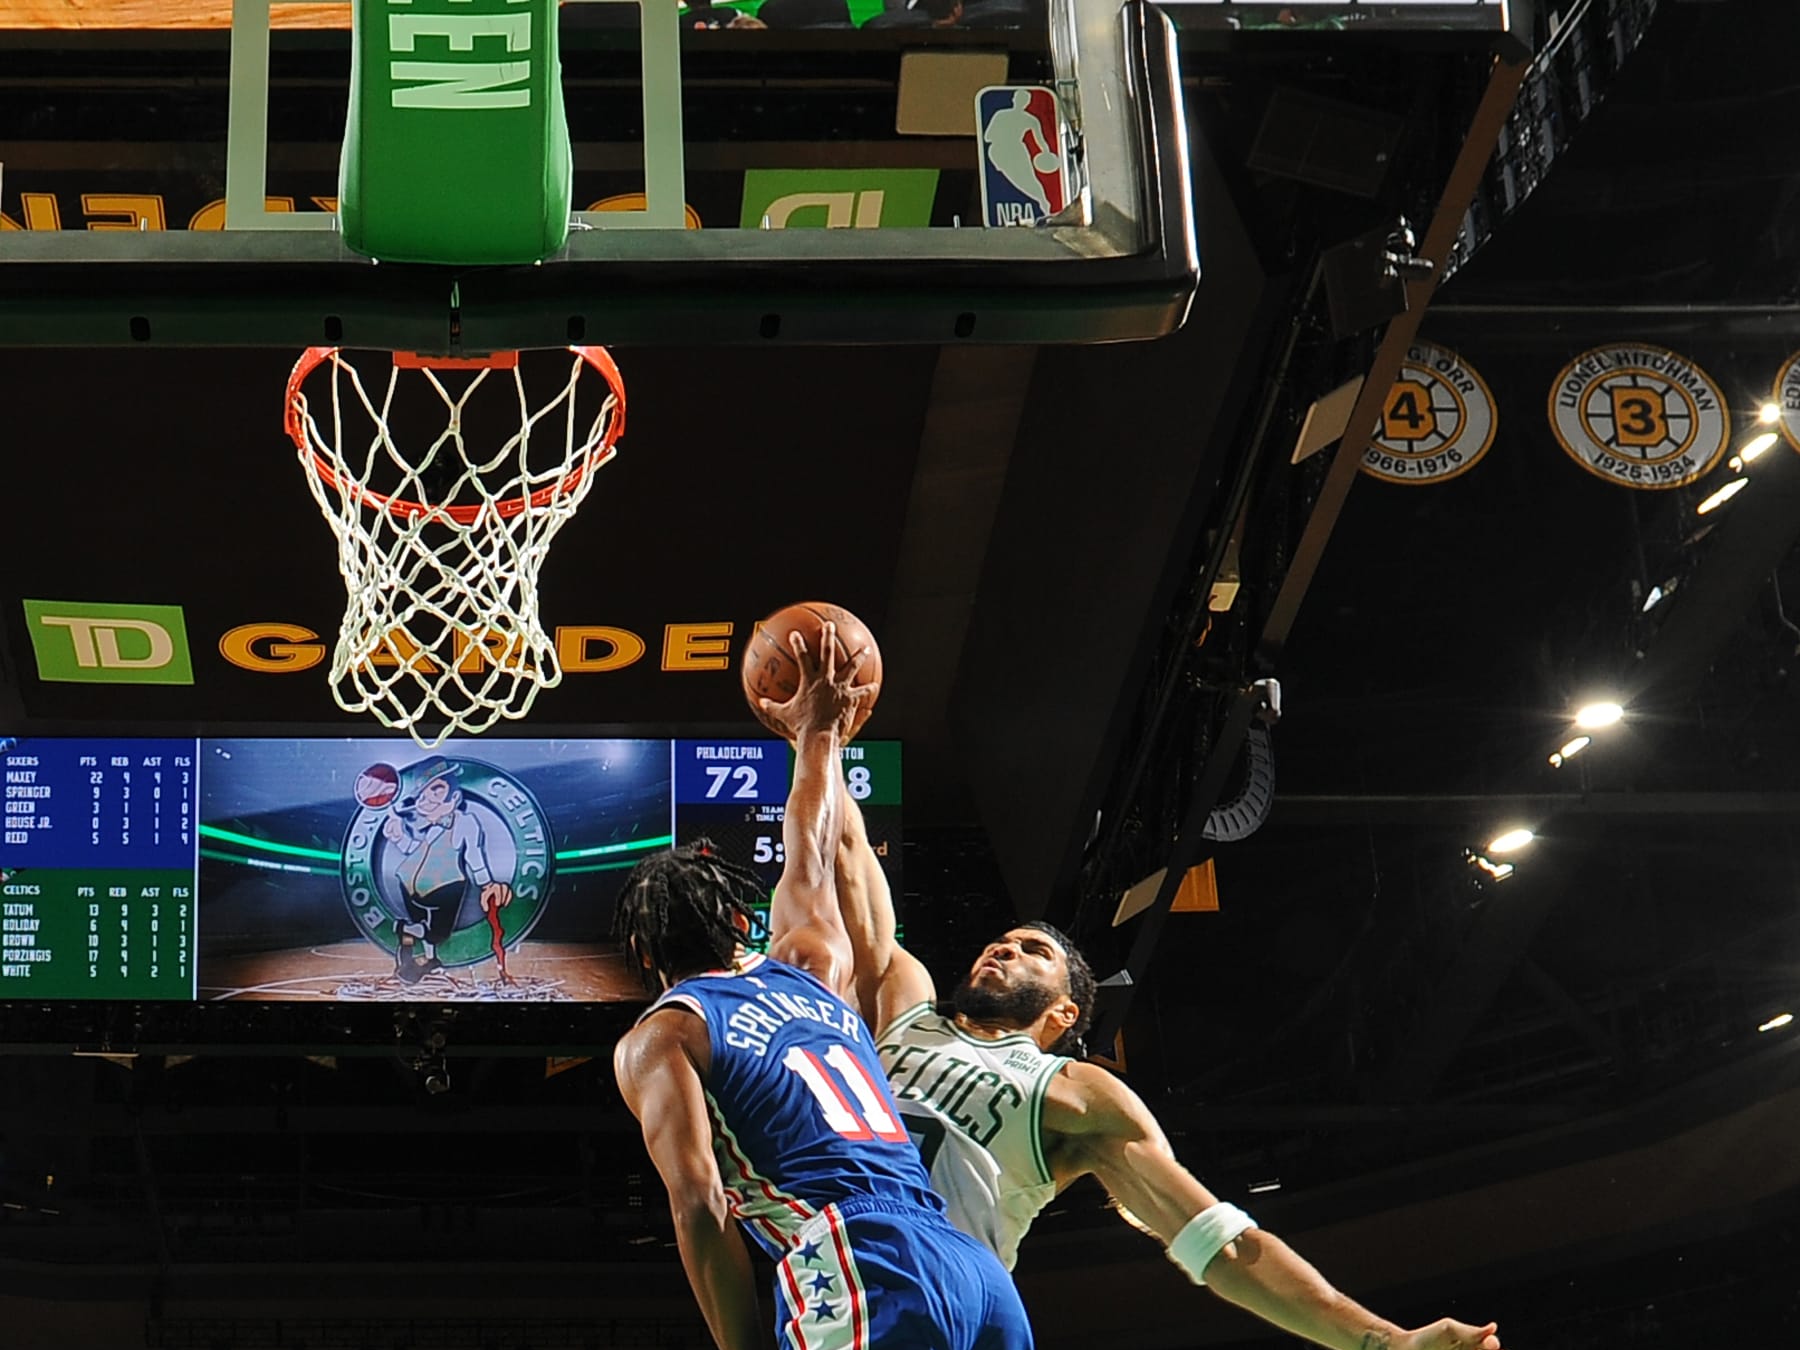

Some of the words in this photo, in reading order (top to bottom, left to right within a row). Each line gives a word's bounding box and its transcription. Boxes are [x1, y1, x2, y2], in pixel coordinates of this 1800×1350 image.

[389, 0, 531, 108] EN
[1435, 360, 1475, 394] ORR
[1560, 354, 1613, 408] LIONEL
[1617, 351, 1715, 411] HITCHMAN
[1390, 391, 1424, 429] 4
[1620, 398, 1656, 436] 3
[1366, 448, 1463, 475] 966-1976
[1594, 453, 1696, 481] 1925-1934
[41, 615, 173, 668] TD
[219, 621, 766, 674] GARDE
[7, 757, 39, 766] SIXERS
[80, 757, 96, 766] PTS
[111, 757, 128, 766] REB
[143, 757, 161, 766] AST
[175, 757, 190, 766] FLS
[697, 747, 763, 759] PHILADELPHIA
[7, 771, 36, 783] MAXEY
[90, 772, 104, 784] 22
[123, 772, 131, 783] 4
[154, 772, 161, 783] 4
[182, 772, 189, 784] 3
[706, 766, 758, 798] 72
[848, 766, 872, 799] 8
[6, 786, 50, 798] SPRINGER
[93, 787, 100, 798] 9
[123, 787, 130, 799] 3
[153, 787, 161, 799] 0
[183, 787, 188, 799] 1
[6, 801, 35, 813] GREEN
[92, 802, 100, 814] 3
[124, 802, 129, 813] 1
[154, 802, 160, 813] 1
[181, 802, 189, 814] 0
[6, 816, 35, 828] HOUSE
[38, 816, 52, 828] JR.
[92, 817, 99, 829] 0
[122, 817, 130, 829] 3
[154, 817, 160, 829] 1
[181, 817, 189, 829] 2
[5, 832, 28, 843] REED
[92, 832, 99, 844] 5
[122, 832, 130, 844] 5
[154, 833, 159, 844] 1
[181, 833, 188, 844] 4
[487, 776, 544, 900] CELTICS
[3, 885, 40, 895] CELTICS
[78, 887, 94, 896] PTS
[109, 888, 126, 897] REB
[141, 888, 160, 897] AST
[173, 888, 189, 897] FLS
[3, 904, 33, 916] TATUM
[88, 904, 99, 916] 13
[121, 904, 128, 916] 9
[151, 904, 159, 916] 3
[179, 904, 187, 917] 2
[89, 919, 97, 931] 6
[120, 920, 128, 931] 4
[151, 920, 159, 931] 0
[180, 920, 186, 932] 1
[3, 934, 35, 946] BROWN
[88, 935, 99, 946] 10
[120, 935, 128, 947] 3
[152, 935, 157, 947] 1
[179, 935, 186, 947] 3
[3, 949, 51, 961] PORZINGIS
[88, 950, 99, 961] 17
[120, 950, 128, 962] 4
[152, 950, 157, 962] 1
[179, 950, 186, 962] 2
[2, 965, 30, 977] WHITE
[89, 965, 97, 977] 5
[120, 966, 128, 977] 4
[150, 966, 158, 977] 2
[180, 966, 185, 977] 1
[726, 994, 860, 1056] SPRINGER
[1010, 1049, 1042, 1067] VISTA
[1004, 1059, 1038, 1075] PRINT
[782, 1045, 909, 1143] 11
